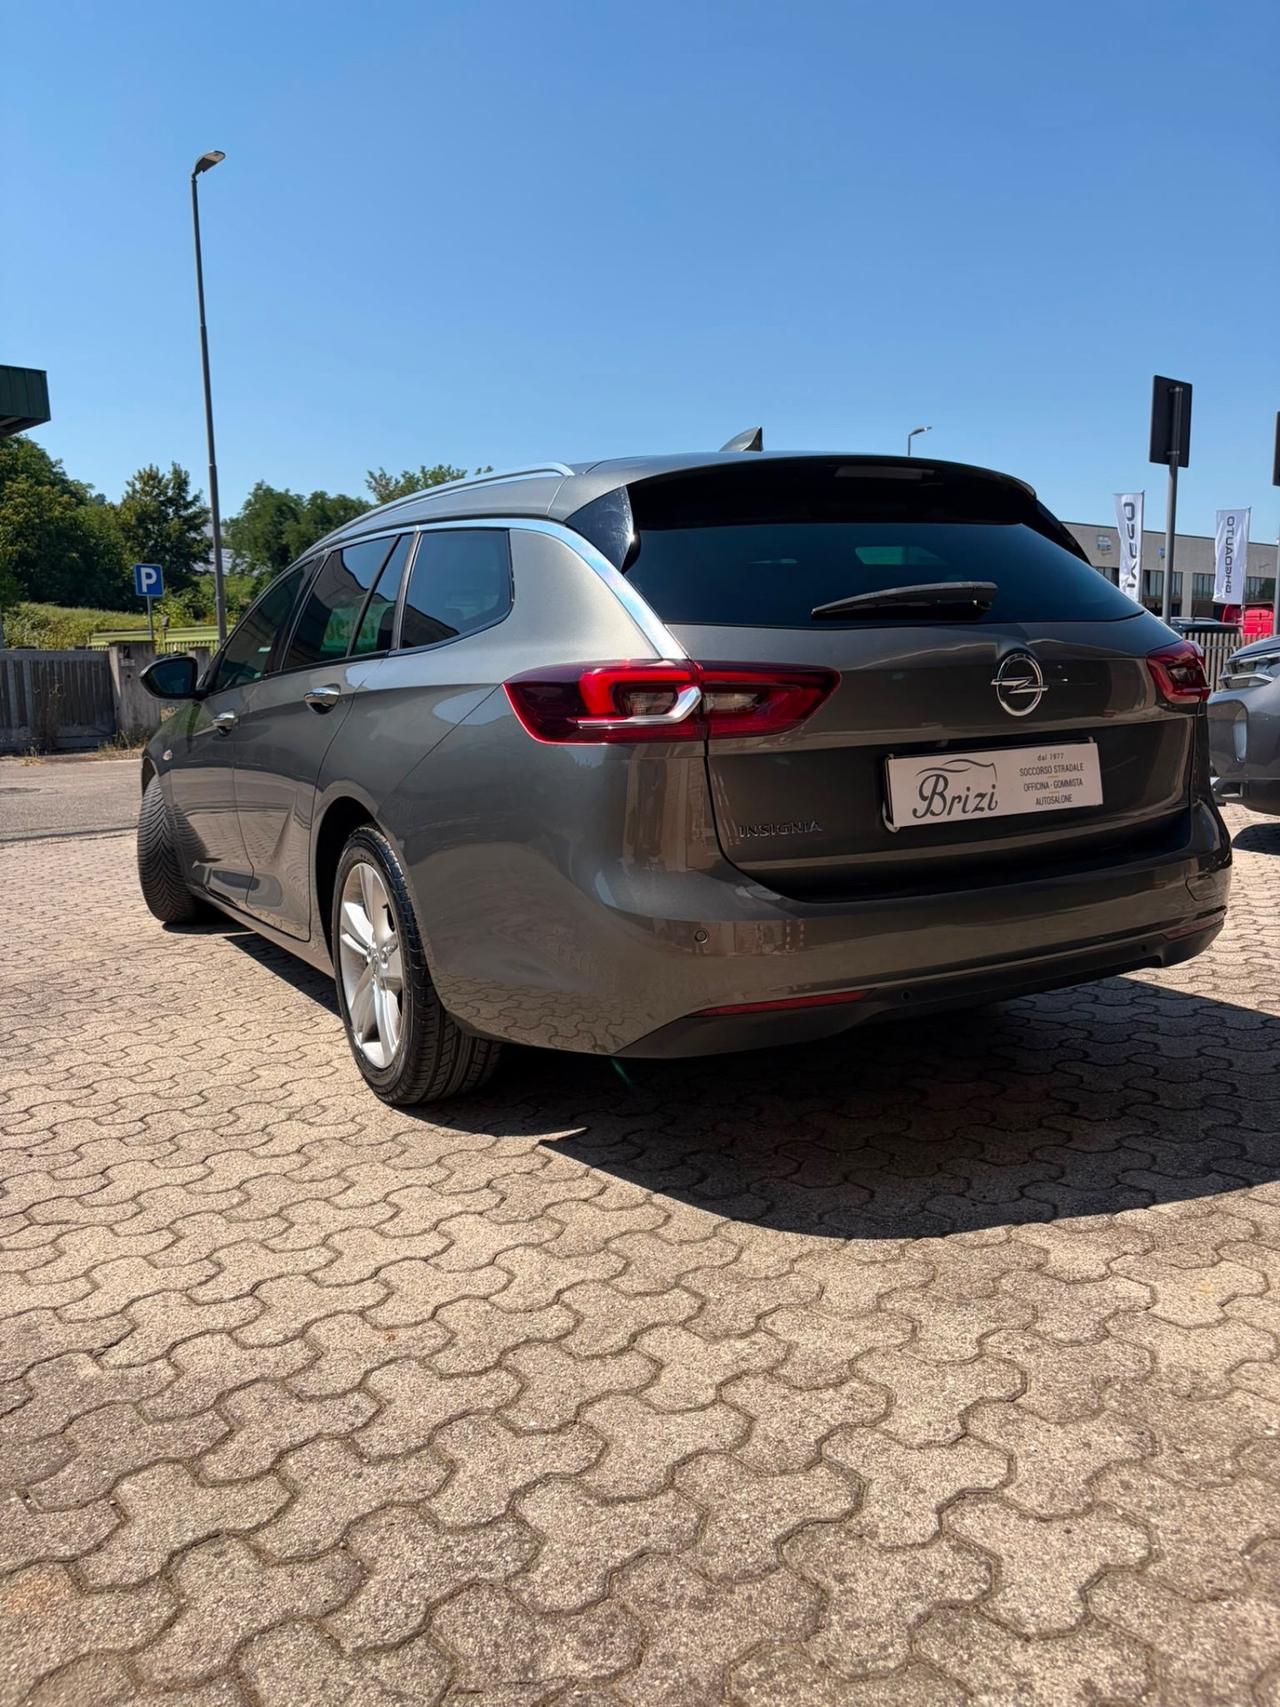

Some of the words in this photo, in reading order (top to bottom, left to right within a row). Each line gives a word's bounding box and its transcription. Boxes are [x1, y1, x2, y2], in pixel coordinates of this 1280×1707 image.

[140, 567, 157, 592] P
[1037, 753, 1048, 761] dal
[1050, 752, 1064, 760] 1977
[1019, 765, 1053, 776] SOCCORSO
[1053, 762, 1084, 774] STRADALE
[1023, 781, 1050, 792] OFFICINA
[1053, 778, 1084, 788] GOMMISTA
[912, 773, 998, 819] Brizi
[1035, 794, 1073, 806] AUTOSALONE
[739, 820, 823, 838] INSIGNIA
